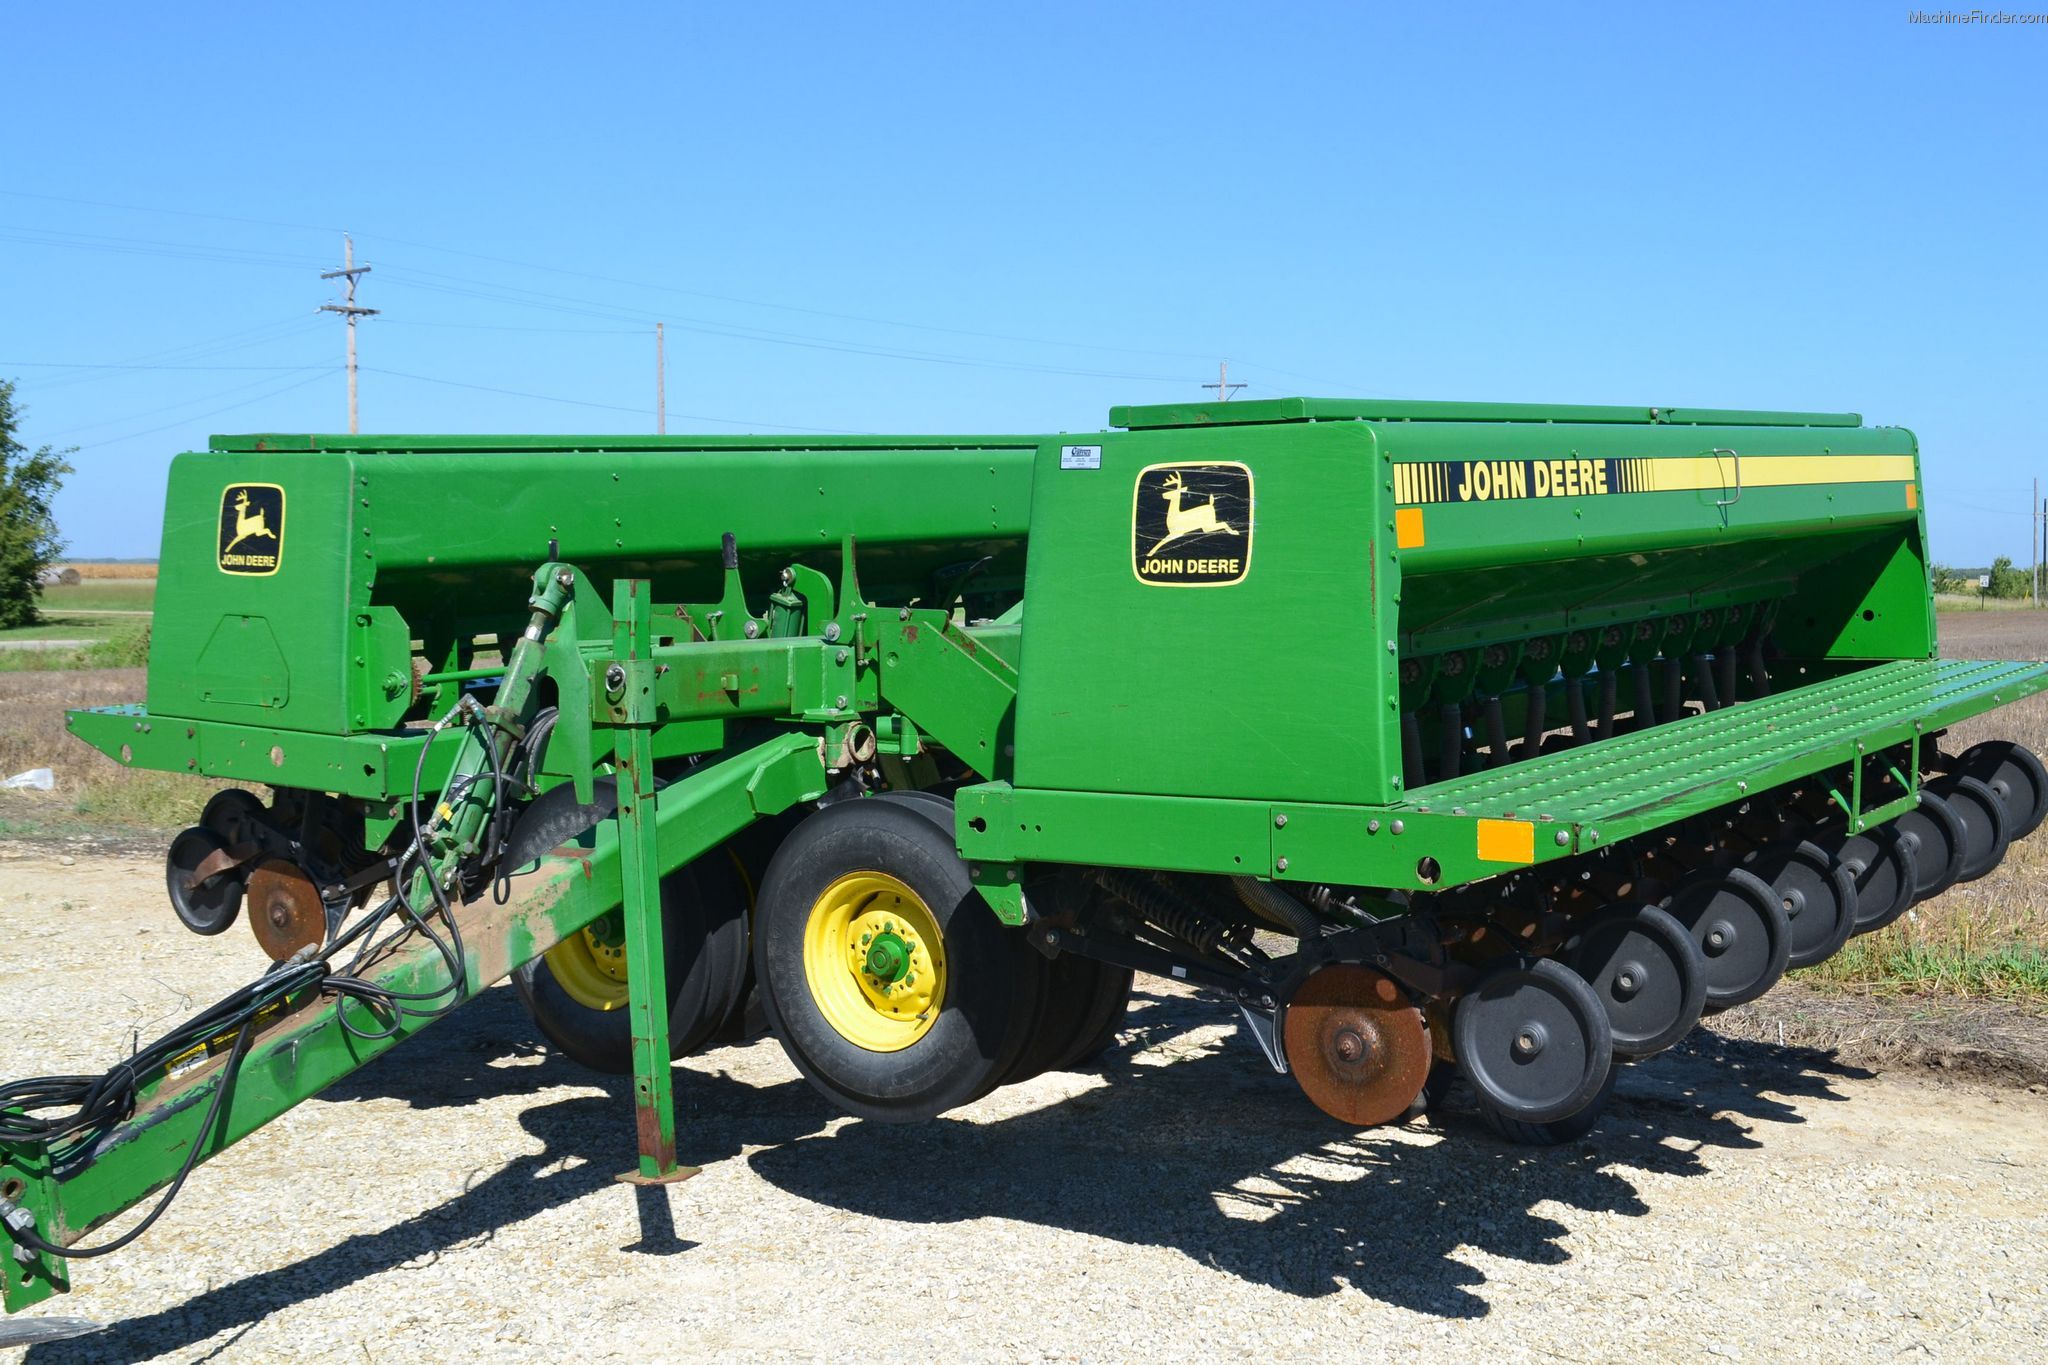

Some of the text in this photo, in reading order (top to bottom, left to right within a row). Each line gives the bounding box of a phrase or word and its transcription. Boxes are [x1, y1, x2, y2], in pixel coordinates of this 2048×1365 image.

[1458, 459, 1608, 502] JOHN DEERE
[221, 554, 276, 567] JOHN DEERE
[1141, 559, 1239, 574] JOHN DEERE
